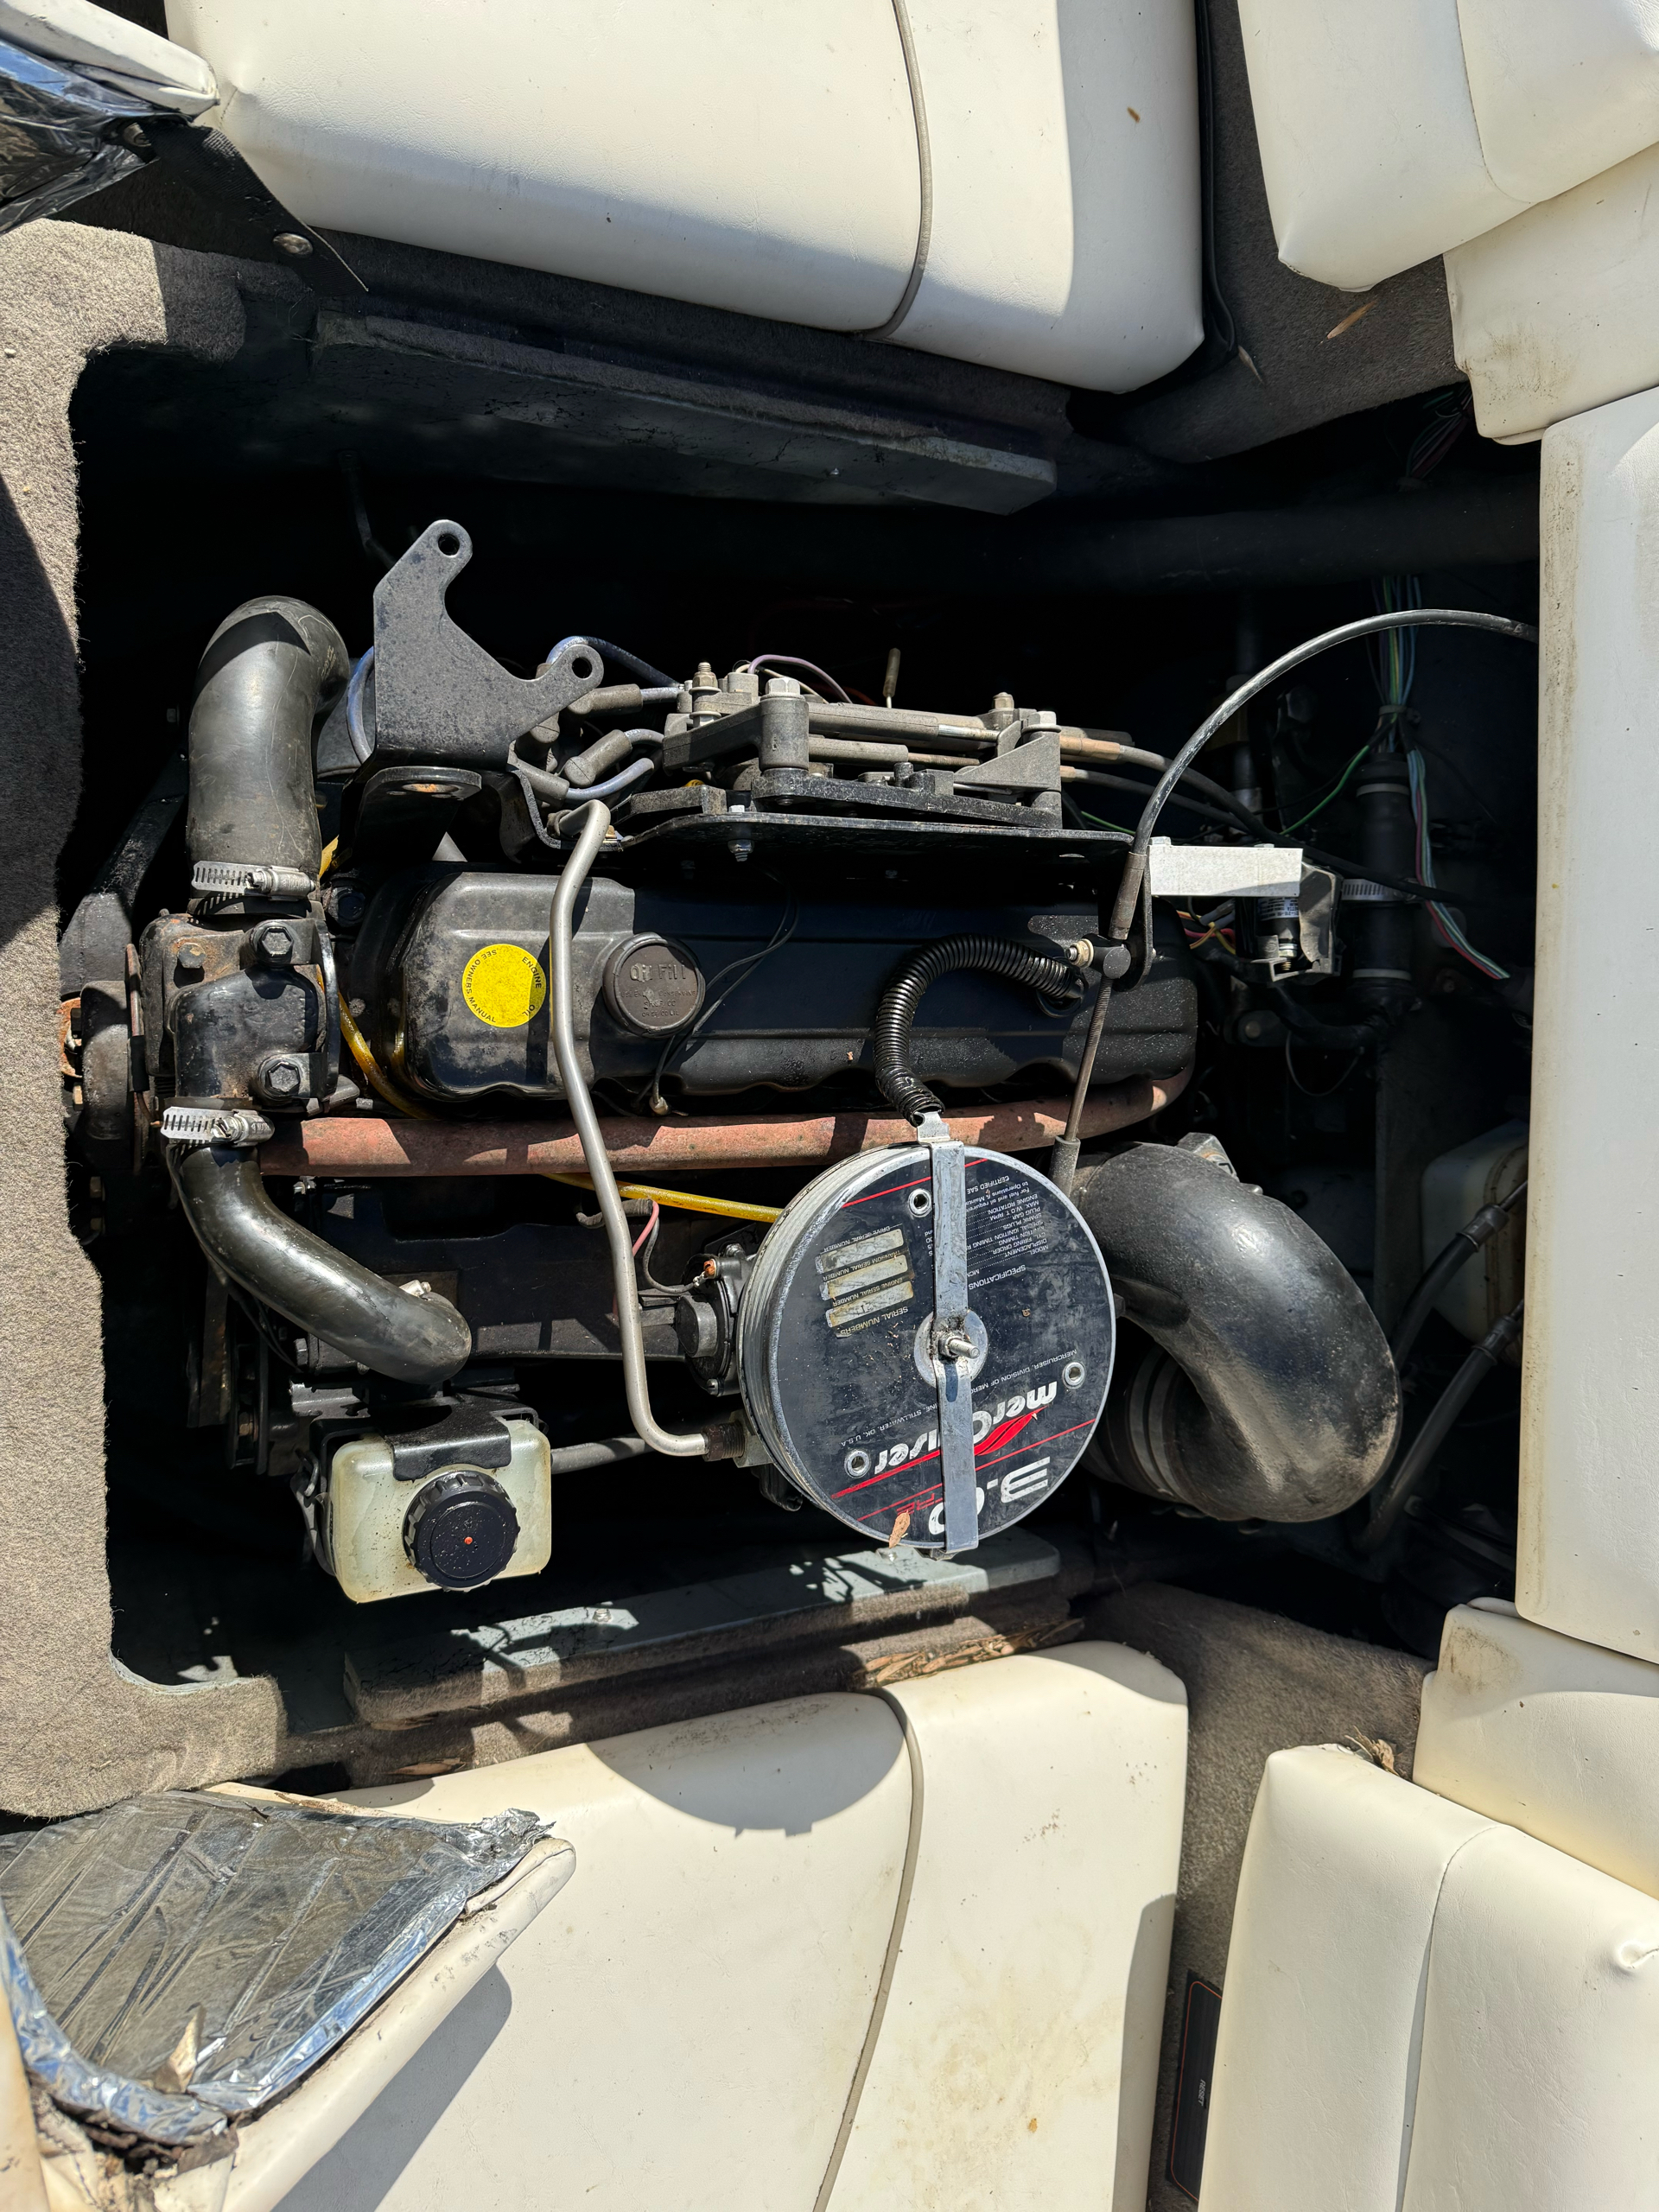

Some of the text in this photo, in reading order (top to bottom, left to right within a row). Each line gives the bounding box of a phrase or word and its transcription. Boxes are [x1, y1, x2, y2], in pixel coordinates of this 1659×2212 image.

[658, 964, 686, 980] Fill
[467, 950, 497, 1022] SEE OWNERS MANUAL
[522, 957, 542, 1016] ENGINE OIL
[966, 1173, 1009, 1194] CERTIFIED SAE
[991, 1182, 1020, 1198] Operations
[997, 1194, 1007, 1203] and
[1008, 1190, 1019, 1198] fuel
[1016, 1192, 1038, 1205] ENGINE
[1022, 1211, 1041, 1223] SPARK
[1025, 1205, 1040, 1216] PLUG
[823, 1225, 890, 1253] DRIVE SERIAL NUMBER
[994, 1227, 1019, 1240] IGNITION
[972, 1236, 993, 1248] TIMING
[1013, 1236, 1032, 1247] FIRING
[823, 1249, 900, 1281] TRANSOM SERIAL NUMBER
[880, 1277, 903, 1289] ENGINE
[968, 1263, 1026, 1290] SPECIFICATIONS
[860, 1285, 880, 1296] SERIAL
[832, 1293, 859, 1306] NUMBER
[840, 1306, 908, 1336] SERIAL NUMBERS
[1001, 1366, 1030, 1382] DIVISION
[874, 1382, 1057, 1476] merCiser
